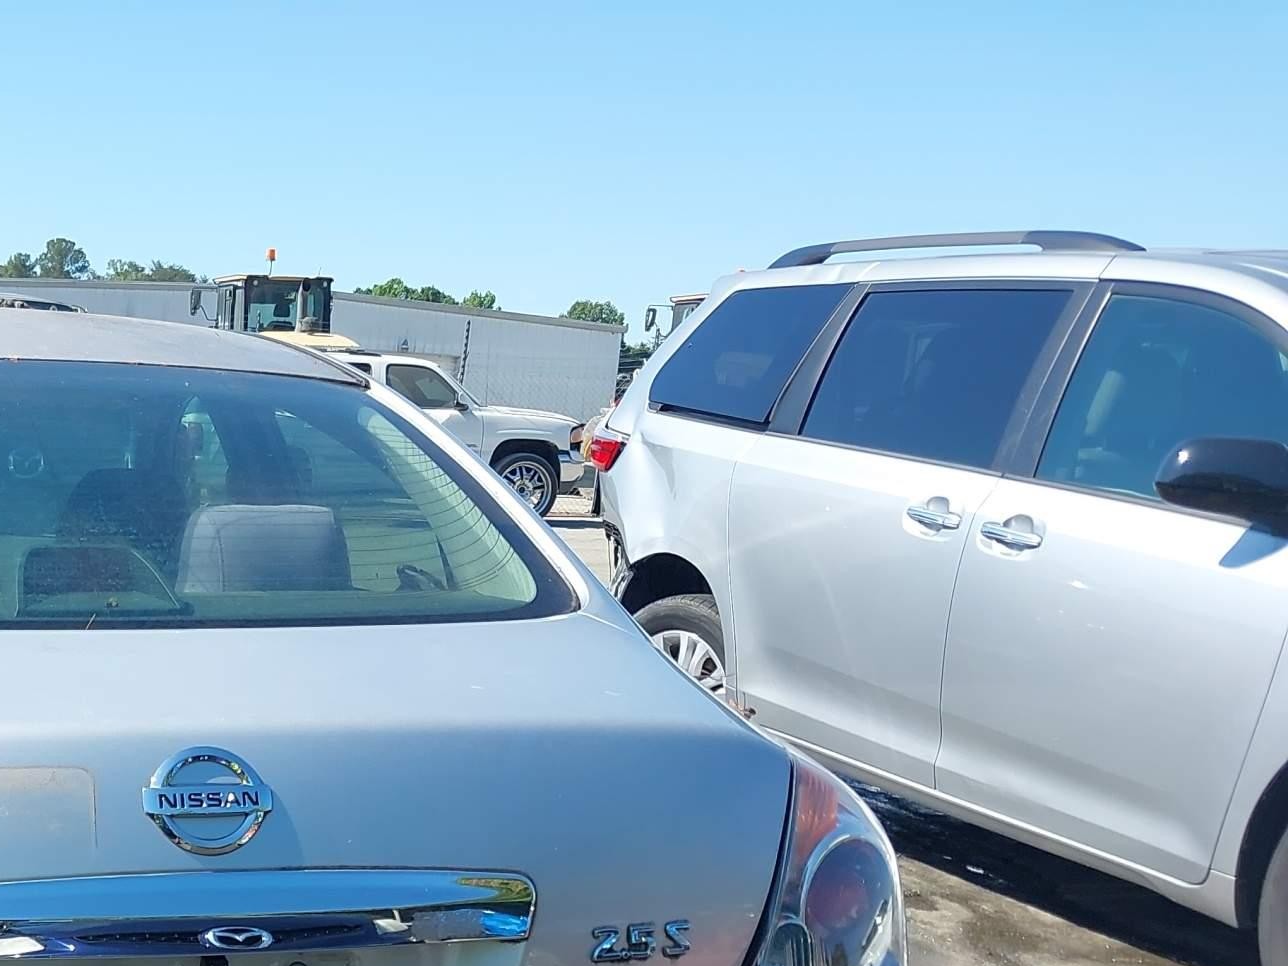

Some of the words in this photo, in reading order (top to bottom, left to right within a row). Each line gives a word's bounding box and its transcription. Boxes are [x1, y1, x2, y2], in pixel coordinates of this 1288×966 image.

[158, 791, 260, 809] NISSAN
[591, 922, 656, 963] 2.5
[663, 919, 691, 958] S
